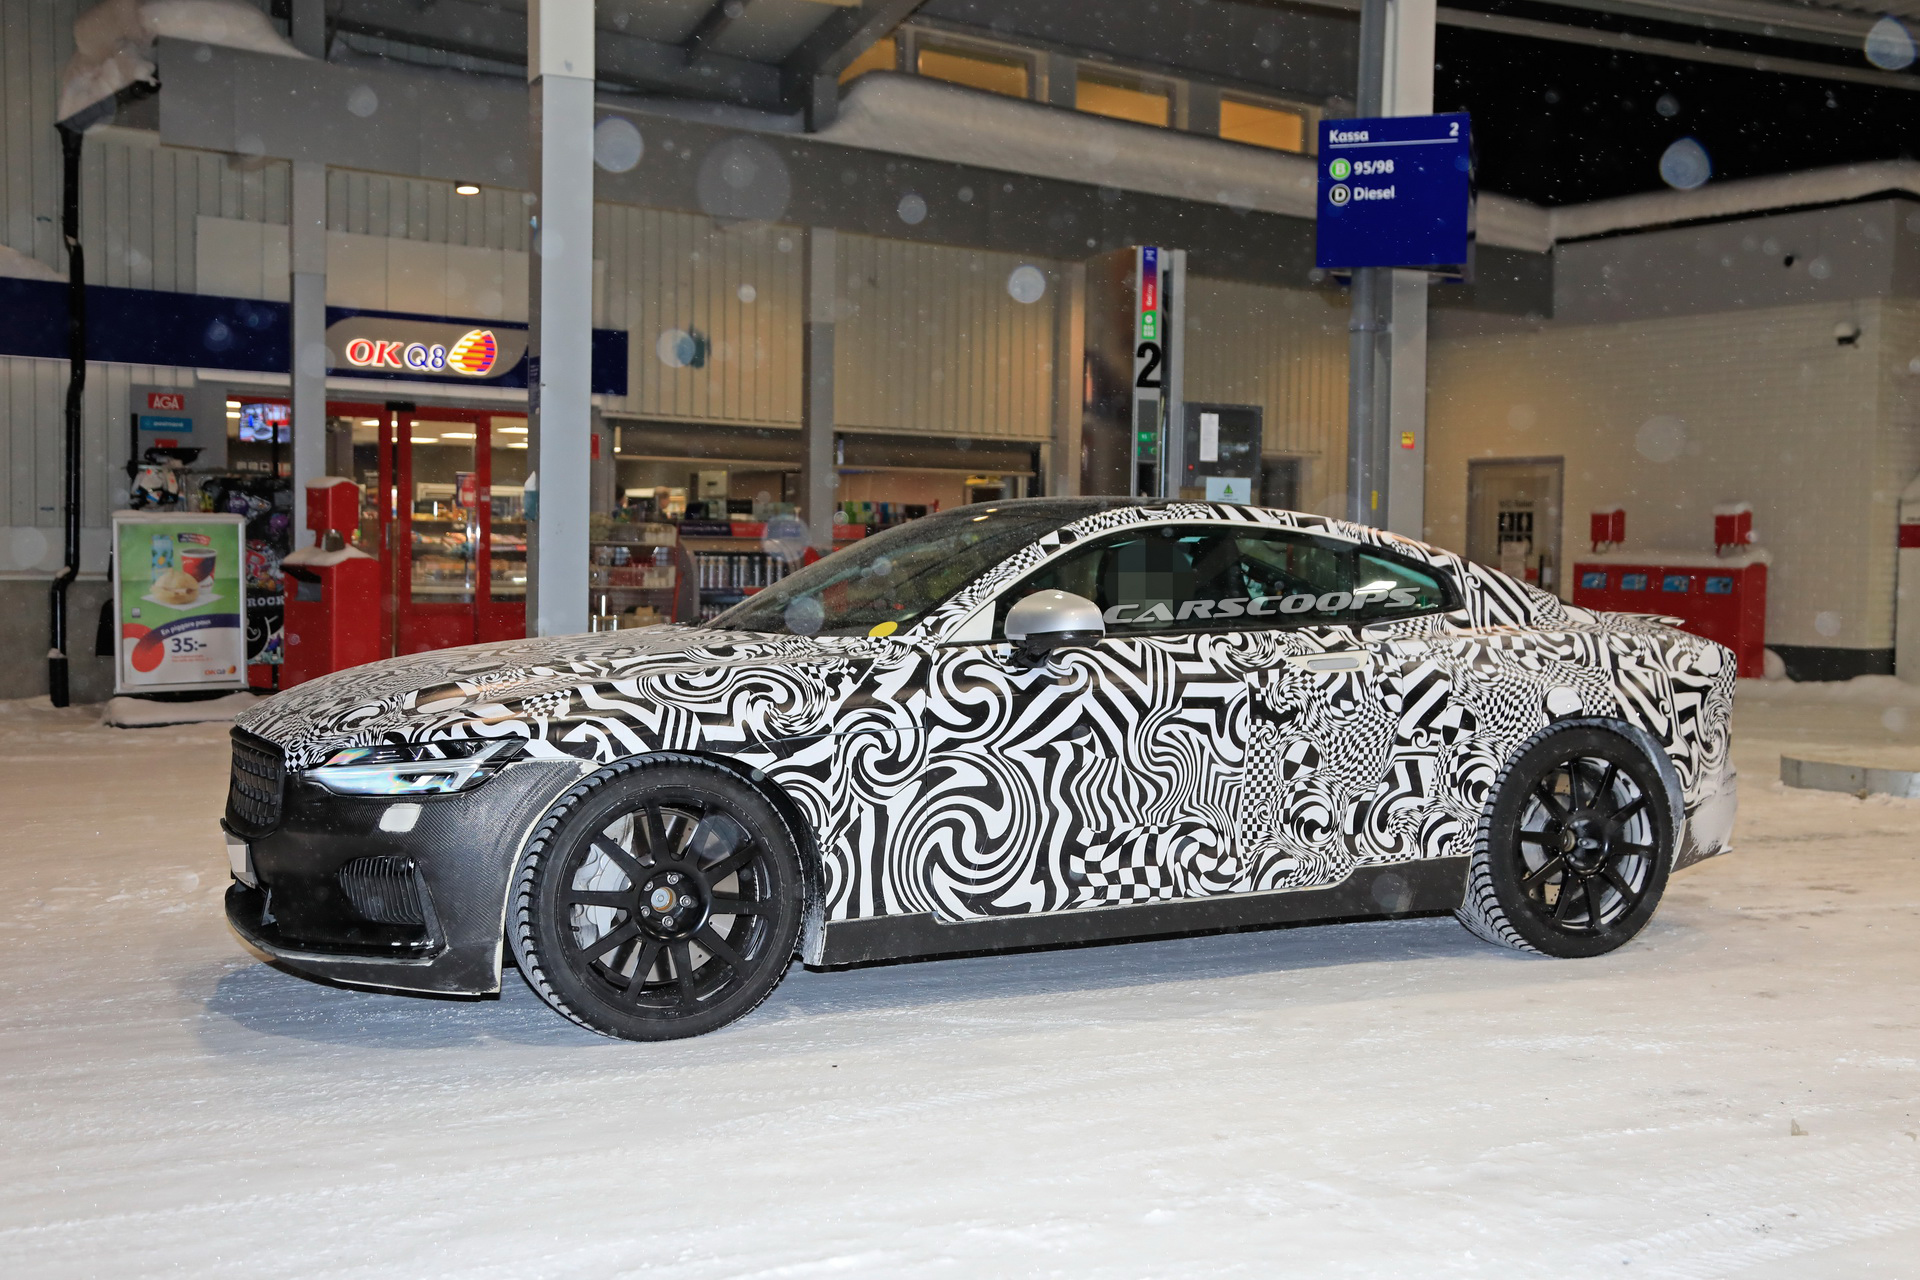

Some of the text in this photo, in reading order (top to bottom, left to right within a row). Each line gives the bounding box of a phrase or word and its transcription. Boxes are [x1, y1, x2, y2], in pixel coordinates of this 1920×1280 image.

[1329, 122, 1459, 143] Kassa 2
[1335, 159, 1395, 176] B 95/98
[1334, 185, 1395, 201] D Diesel
[1136, 342, 1161, 388] 2
[153, 394, 179, 409] AGA
[160, 627, 170, 636] En
